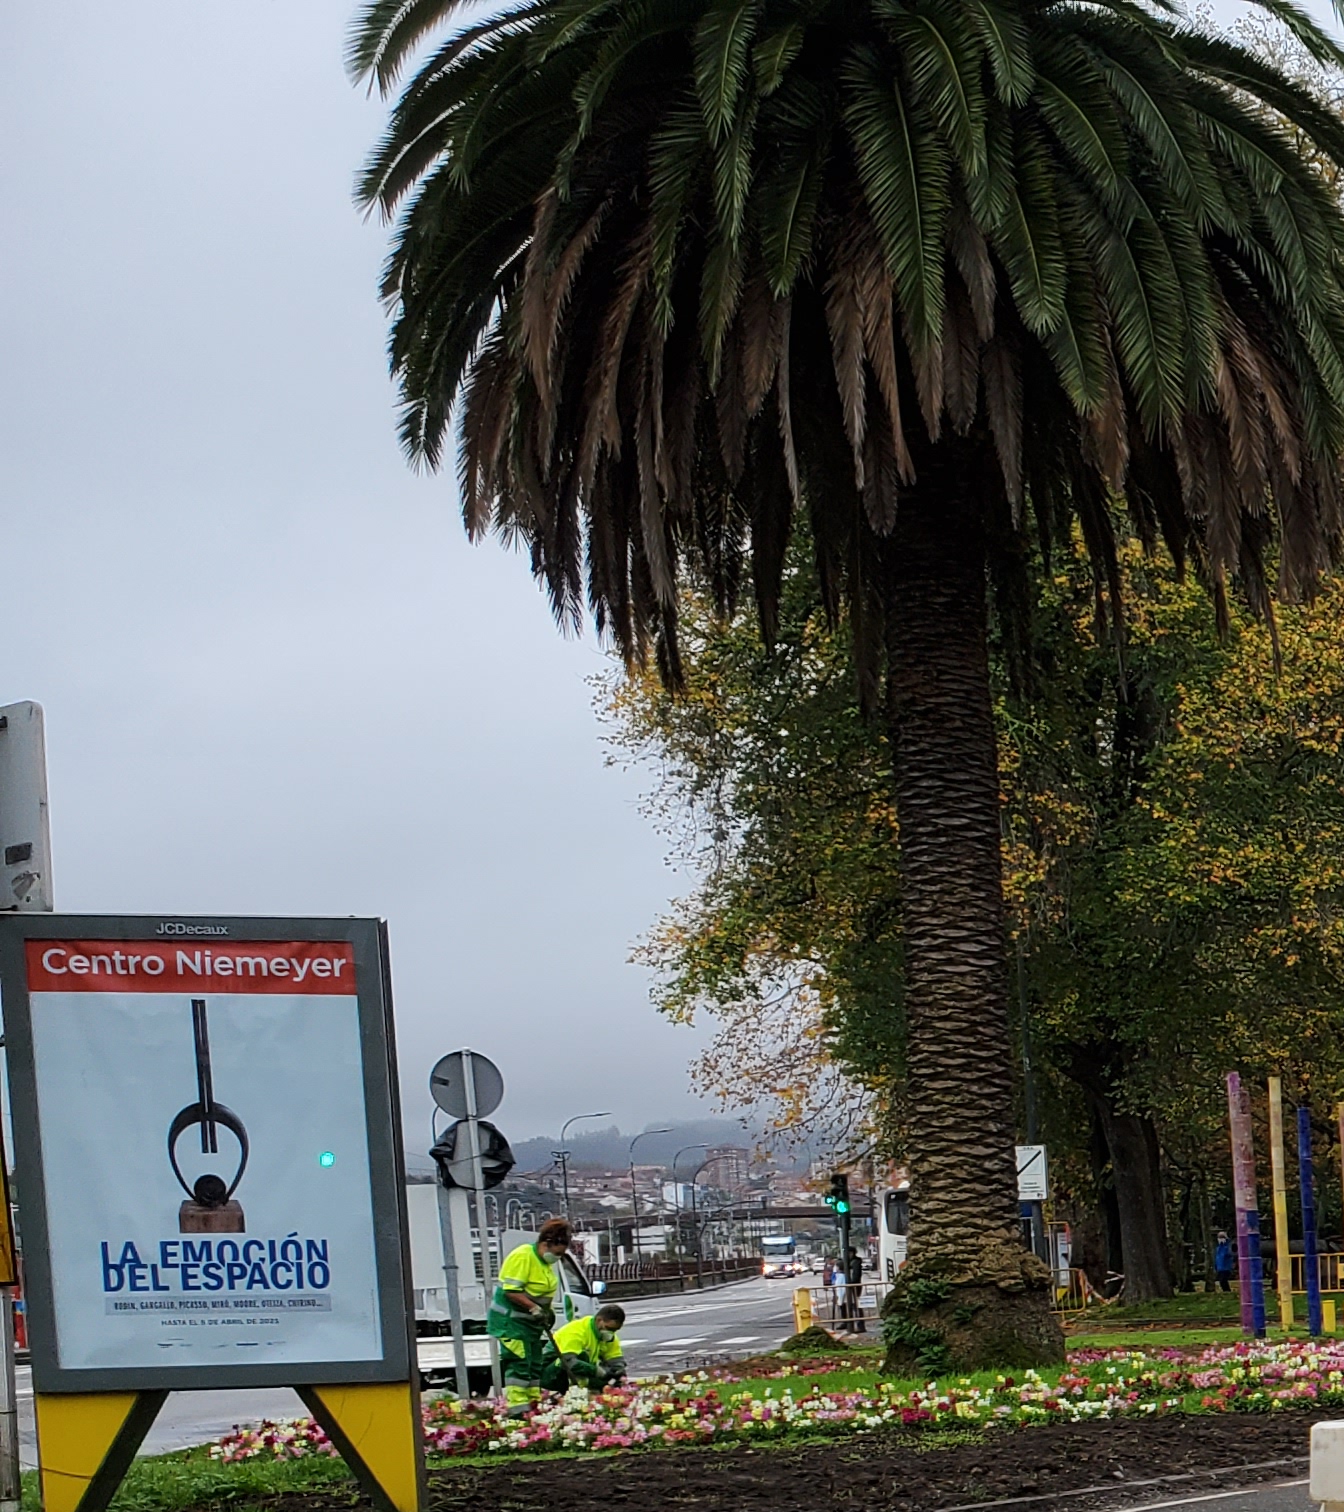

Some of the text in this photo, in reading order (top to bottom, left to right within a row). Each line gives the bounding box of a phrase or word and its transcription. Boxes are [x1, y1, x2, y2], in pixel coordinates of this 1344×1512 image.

[156, 923, 229, 935] JCDecaux
[42, 948, 346, 982] Centro Niemeyer
[101, 1231, 329, 1269] LA EMOCIÓN
[103, 1261, 331, 1292] DEL ESPACIO
